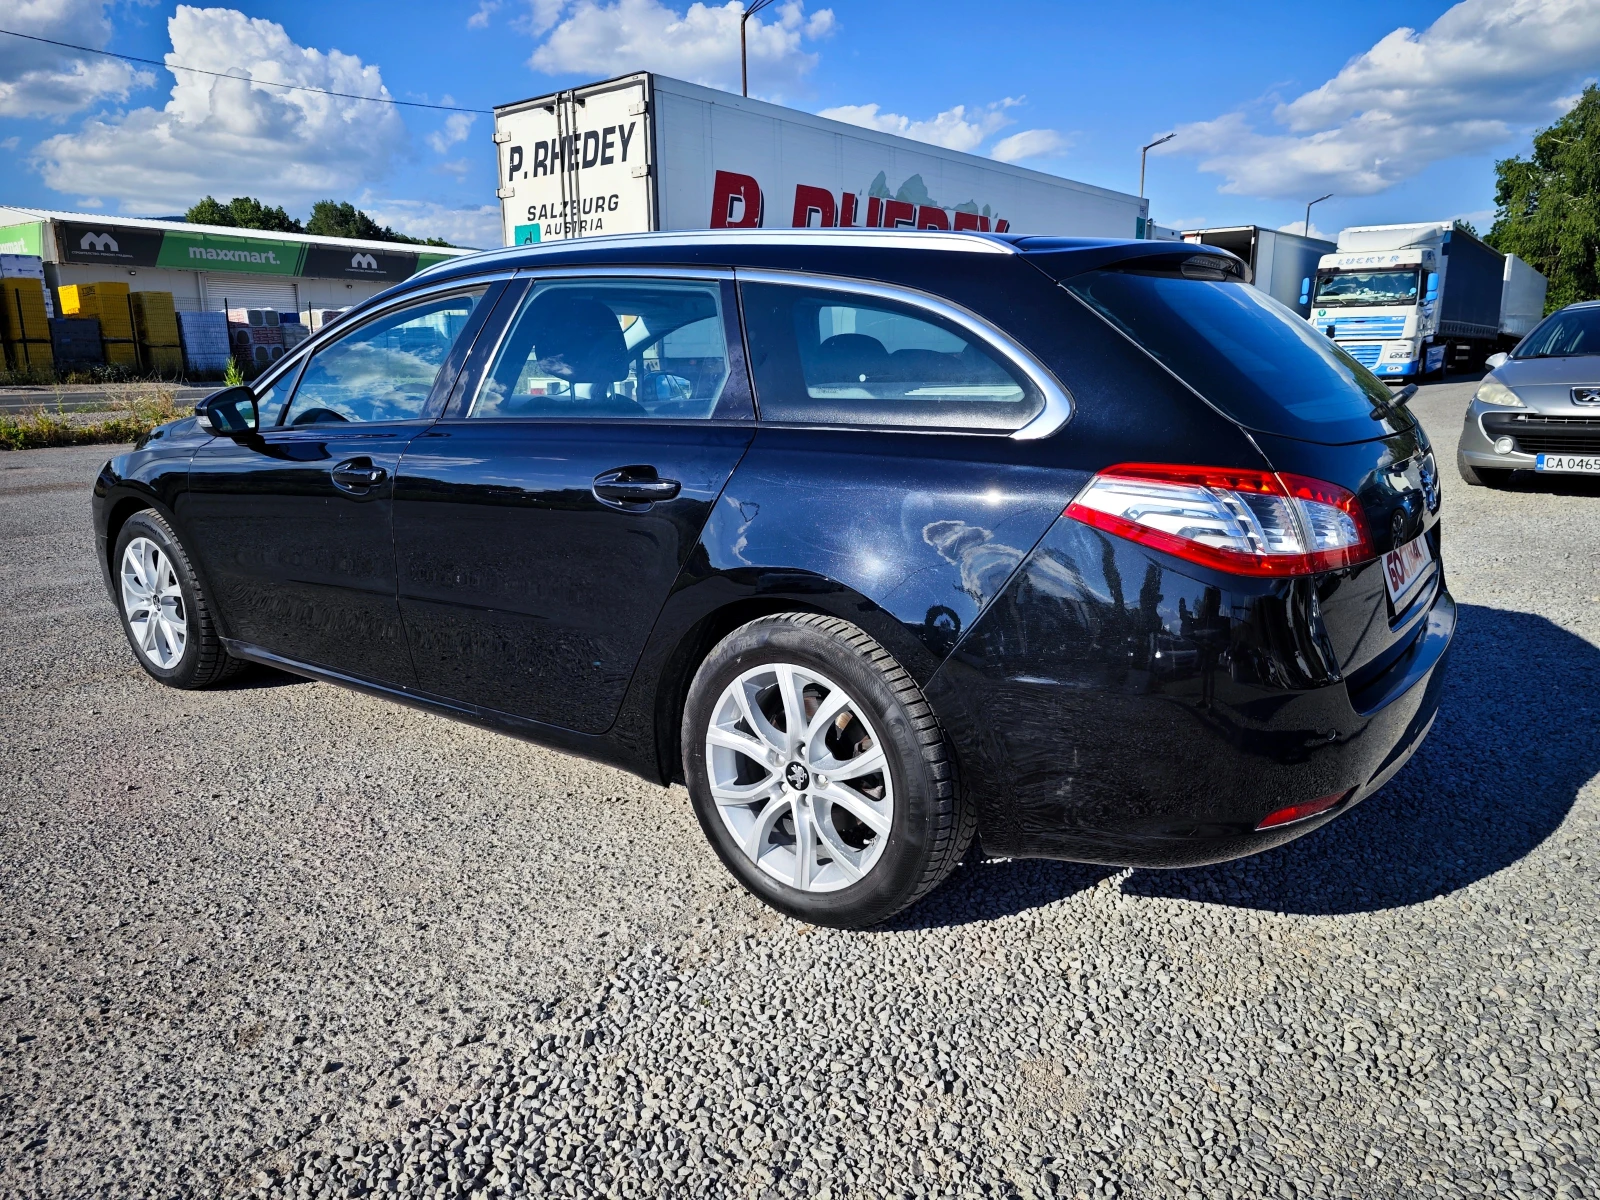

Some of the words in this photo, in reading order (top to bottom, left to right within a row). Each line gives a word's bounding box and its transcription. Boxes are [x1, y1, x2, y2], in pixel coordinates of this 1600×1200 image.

[508, 145, 528, 182] P.
[533, 121, 637, 178] RHEDEY
[527, 193, 620, 222] SALZBURG
[544, 217, 604, 236] AUSTRIA
[188, 246, 281, 265] maxxmart.
[1337, 256, 1386, 266] LUCKY
[1389, 255, 1400, 263] R
[1567, 458, 1600, 471] 0465
